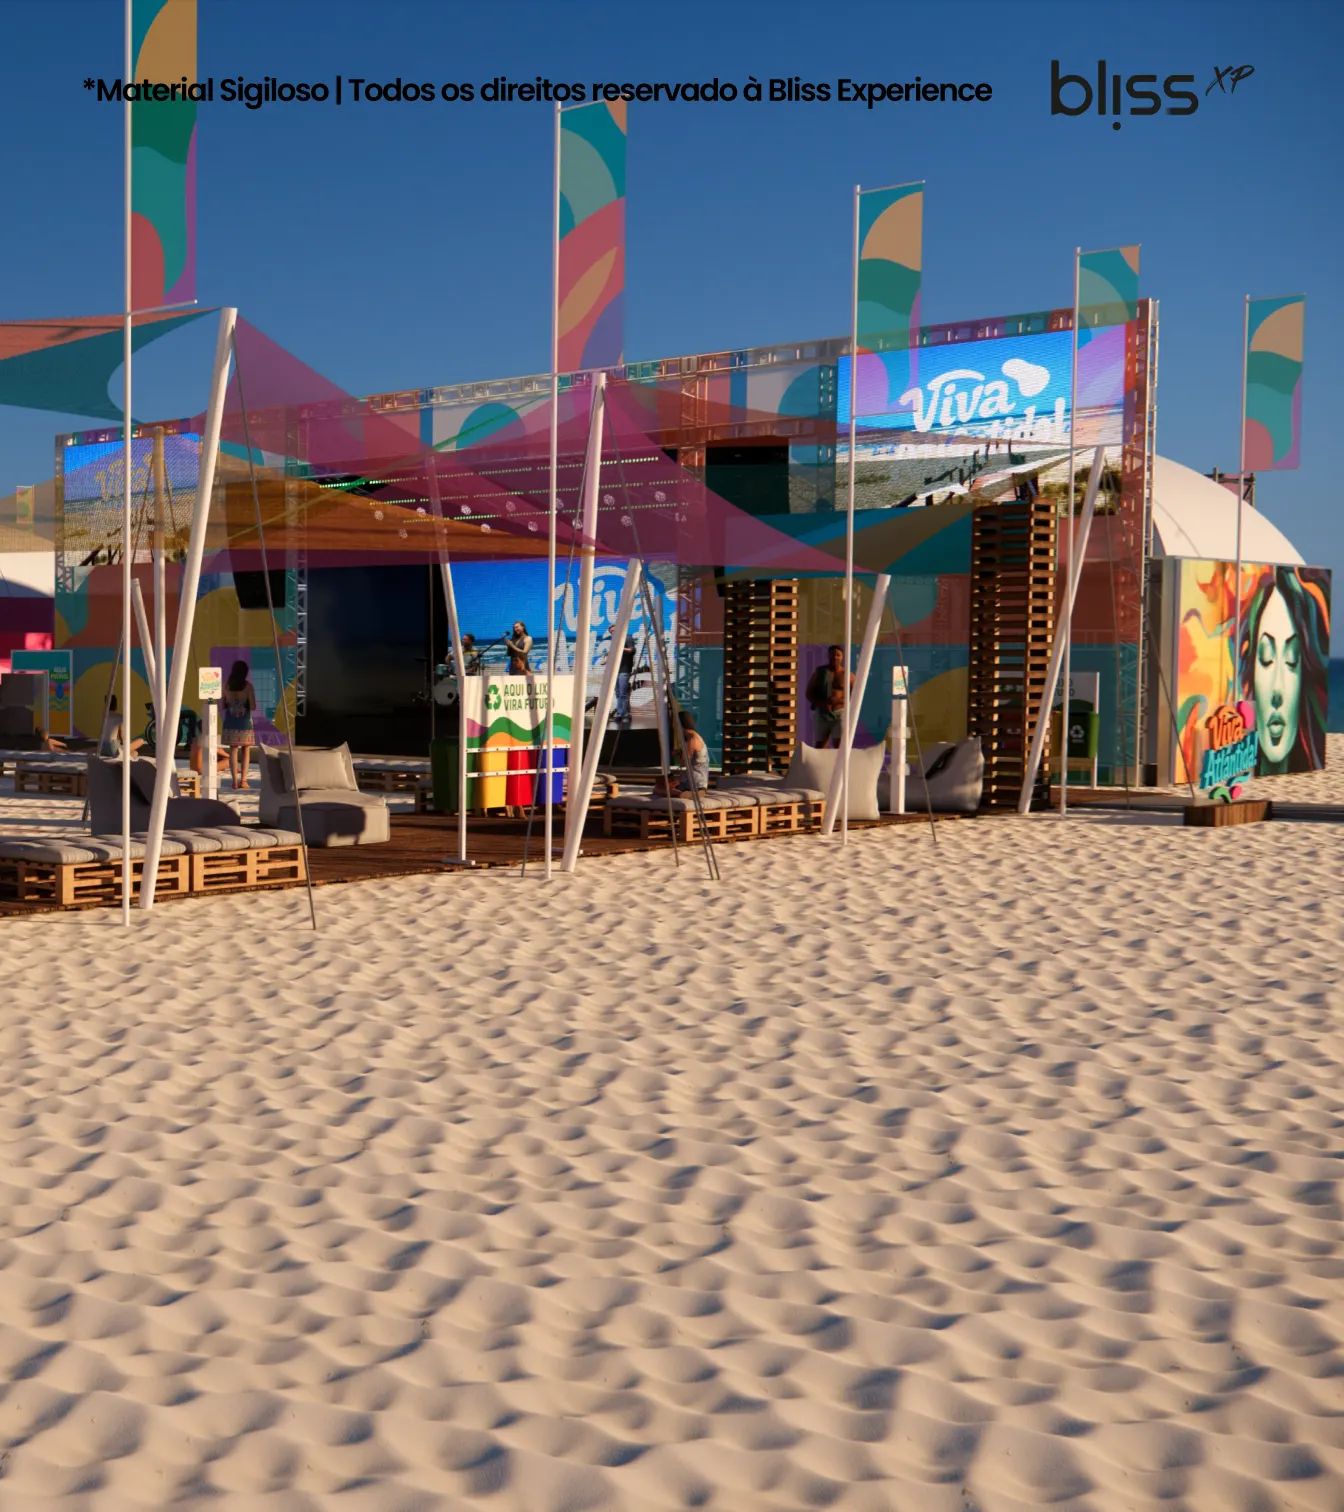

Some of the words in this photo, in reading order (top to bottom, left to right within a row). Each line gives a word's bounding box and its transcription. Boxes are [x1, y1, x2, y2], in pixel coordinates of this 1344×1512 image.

[899, 369, 1017, 433] Viva
[503, 683, 524, 697] AQUI
[527, 683, 533, 696] O
[535, 682, 549, 696] LIX
[503, 698, 523, 711] VIRA
[1204, 705, 1246, 751] Viva
